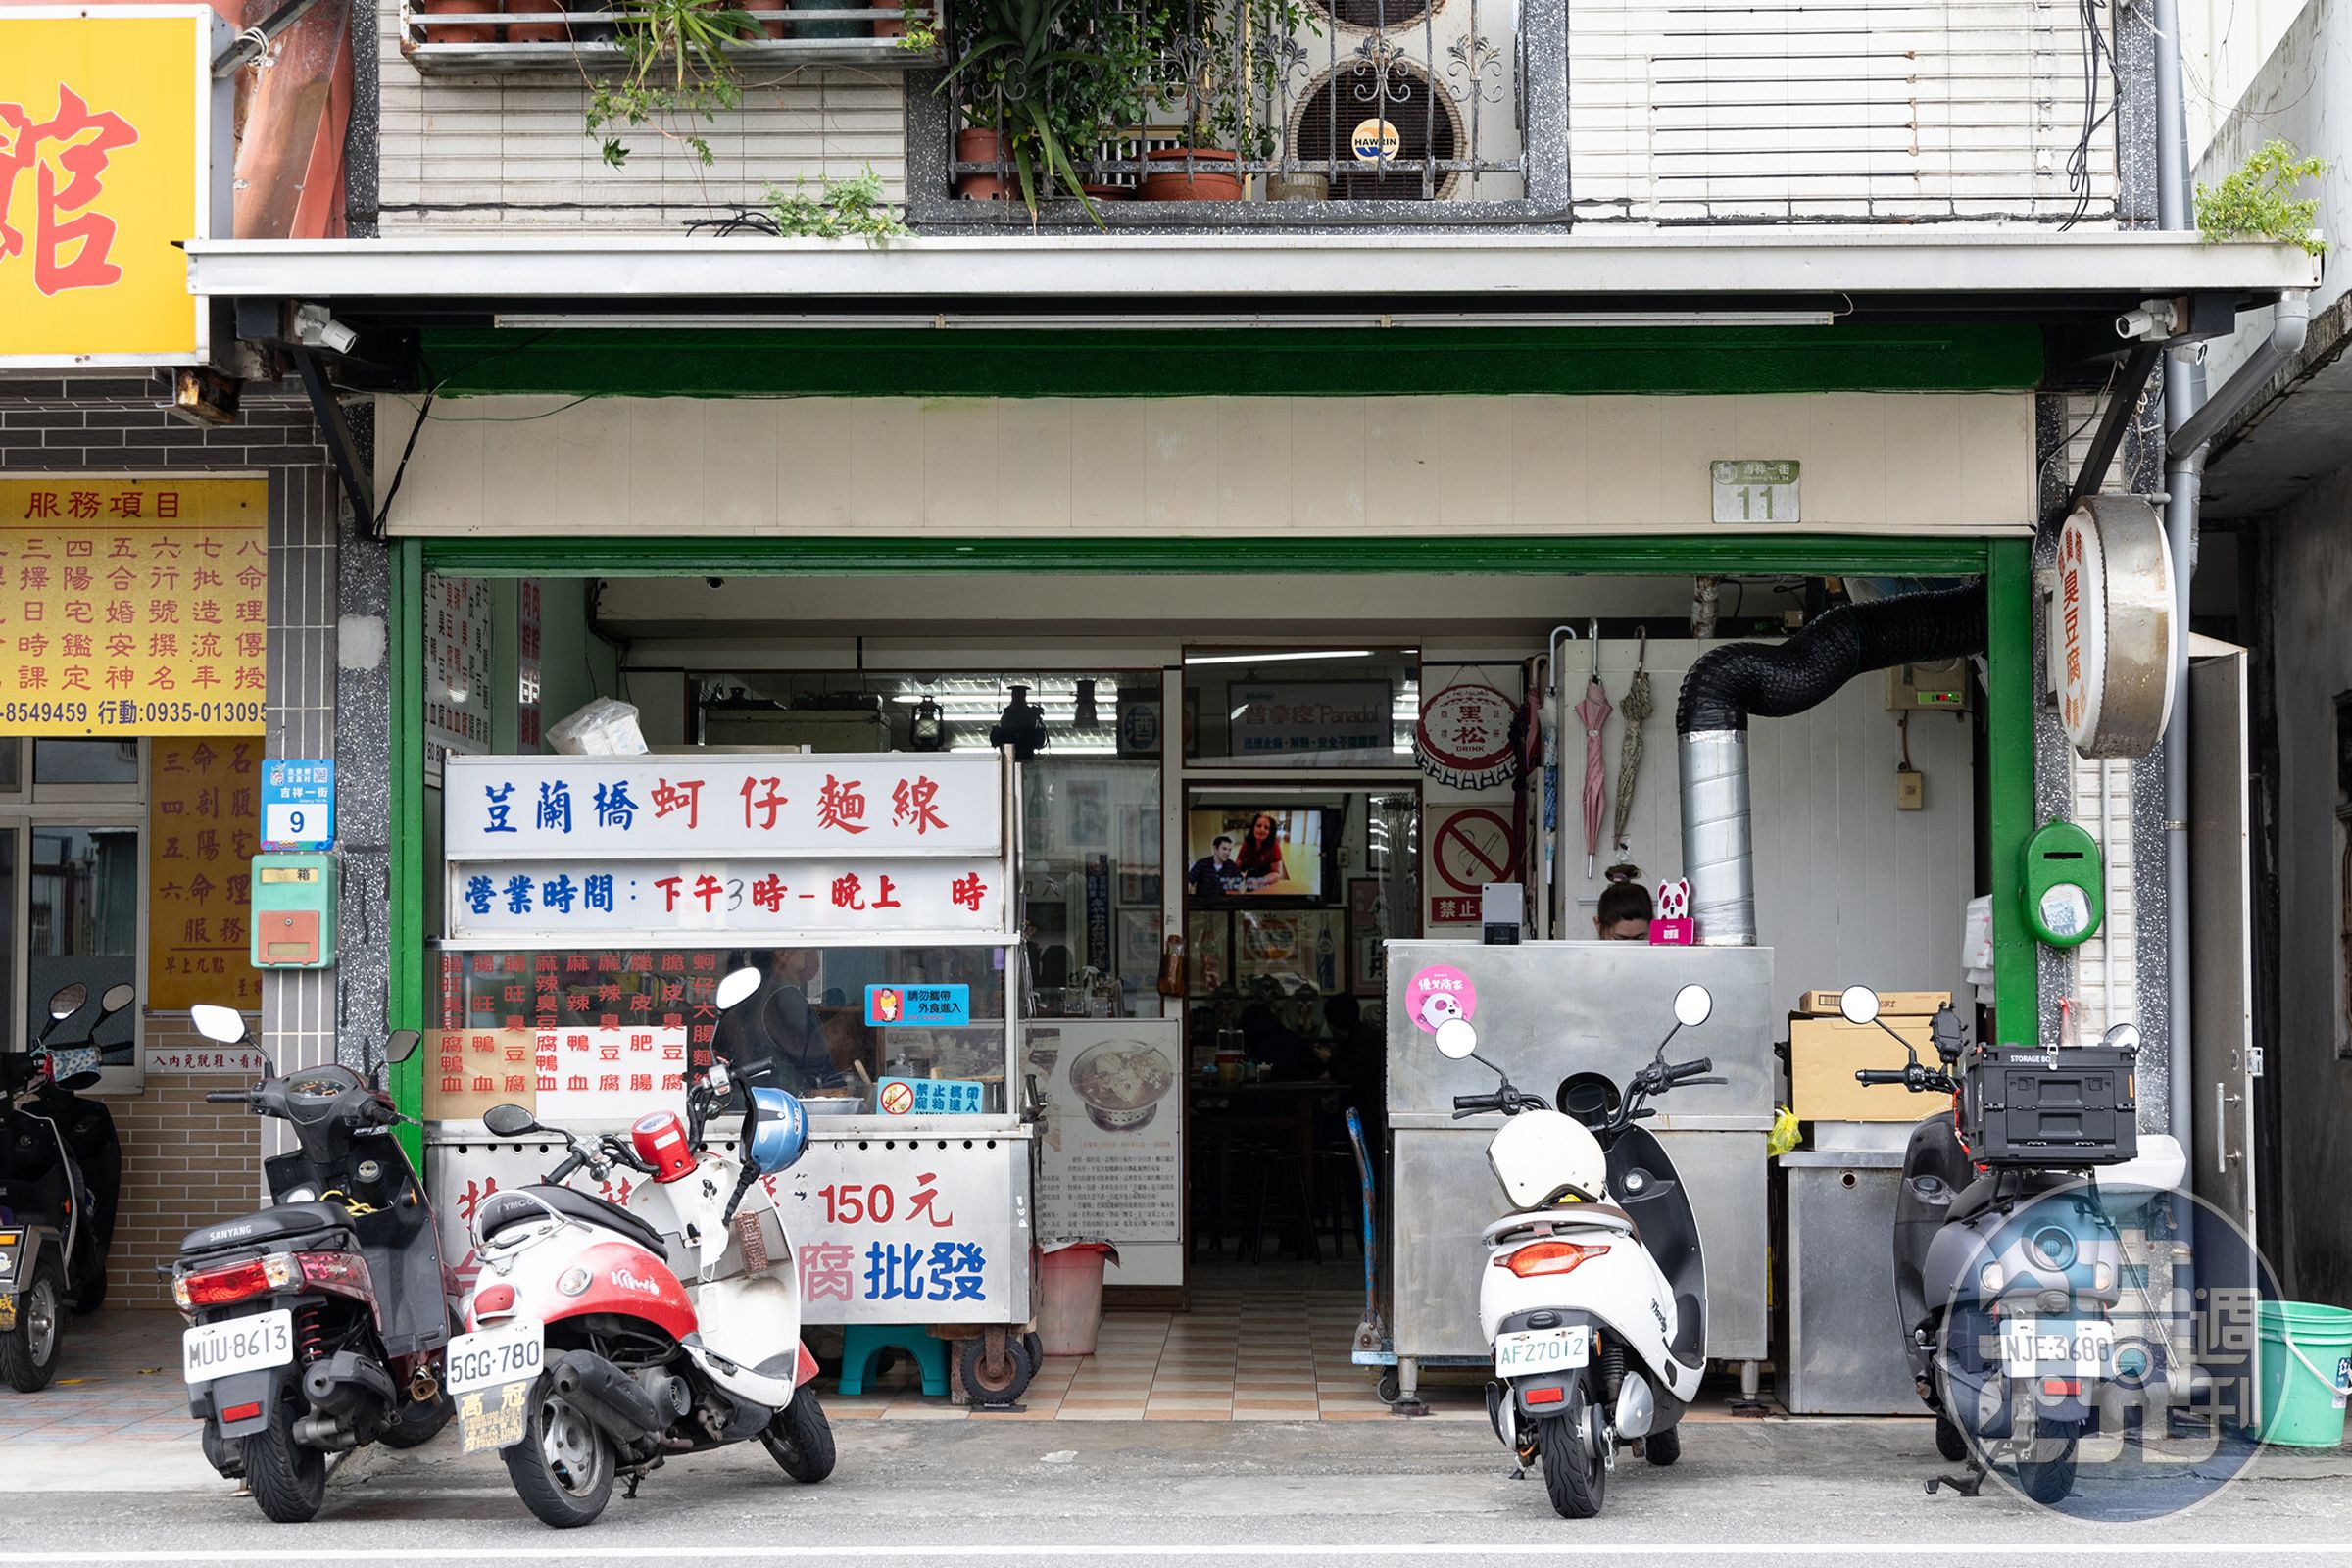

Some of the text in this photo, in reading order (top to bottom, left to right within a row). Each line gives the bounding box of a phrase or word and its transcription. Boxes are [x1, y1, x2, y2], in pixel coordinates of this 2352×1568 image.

[25, 491, 179, 519] 服務項目
[1737, 486, 1773, 520] 11
[2063, 570, 2080, 686] 臭豆腐
[1319, 704, 1379, 725] Panadol
[1452, 706, 1489, 744] 黑松
[1129, 716, 1154, 741] 酒
[280, 787, 328, 798] 吉祥一街
[483, 774, 950, 836] 荳蘭橋蚵仔麵線
[289, 811, 305, 833] 9
[952, 872, 988, 912] 時
[1439, 900, 1482, 919] 禁止
[184, 919, 246, 943] 服務
[165, 956, 225, 975] 早上九點
[907, 990, 951, 1001] 請勿攜帶
[919, 1003, 961, 1013] 外食進入
[662, 954, 684, 1091] 脆皮臭豆腐
[2010, 1054, 2040, 1063] STORAGE
[916, 1083, 980, 1099] 禁止攜帶
[818, 1172, 954, 1227] 150元
[210, 1225, 252, 1242] SANYANG
[1501, 1338, 1584, 1365] AF27012
